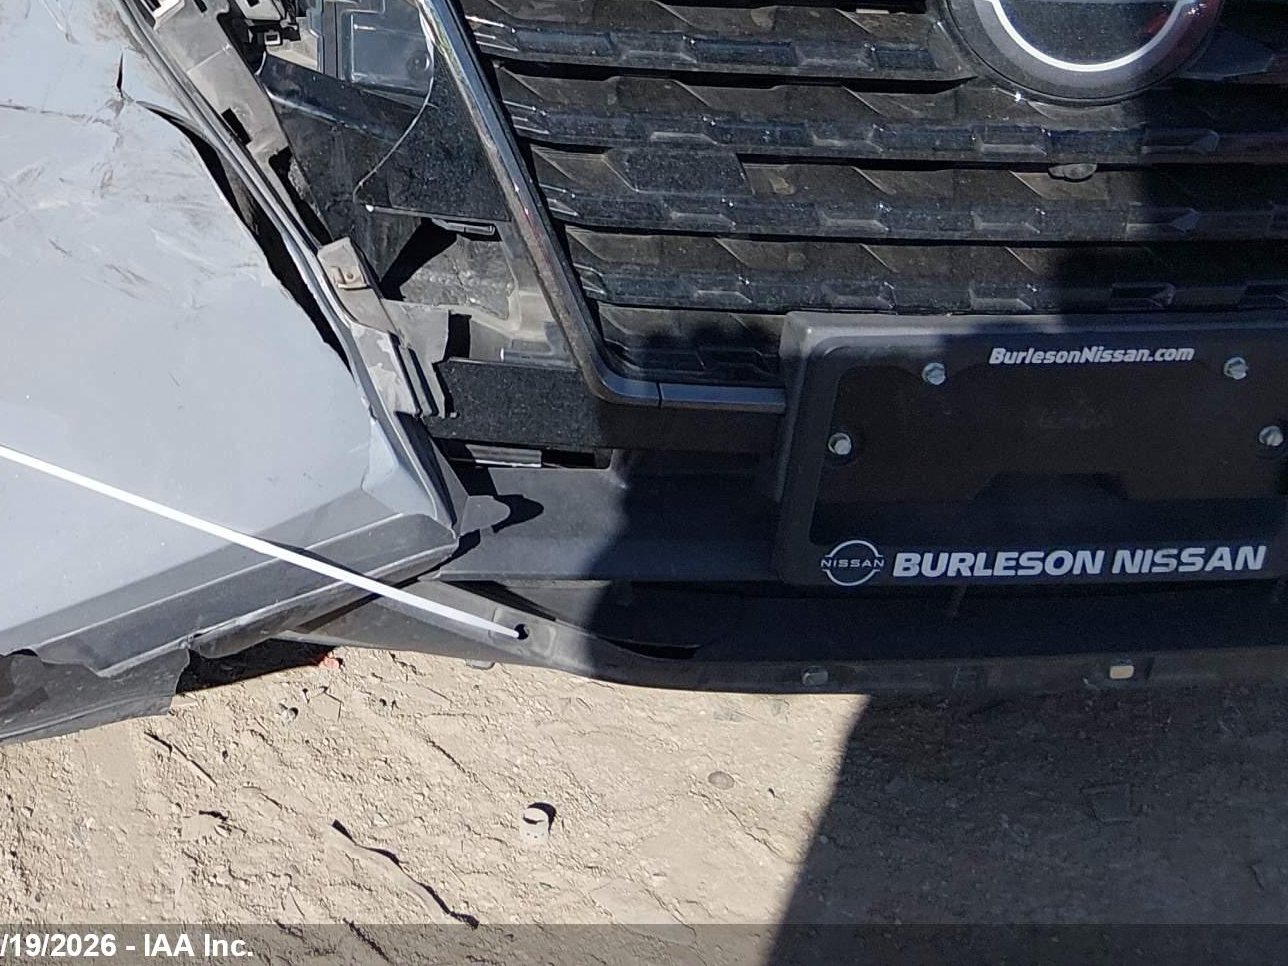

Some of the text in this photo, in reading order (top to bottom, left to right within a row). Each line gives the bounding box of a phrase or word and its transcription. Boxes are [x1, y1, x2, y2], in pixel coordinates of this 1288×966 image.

[988, 346, 1196, 365] BurlesonNissan.com
[820, 557, 885, 568] NISSAN
[892, 545, 1267, 577] BURLESON NISSAN
